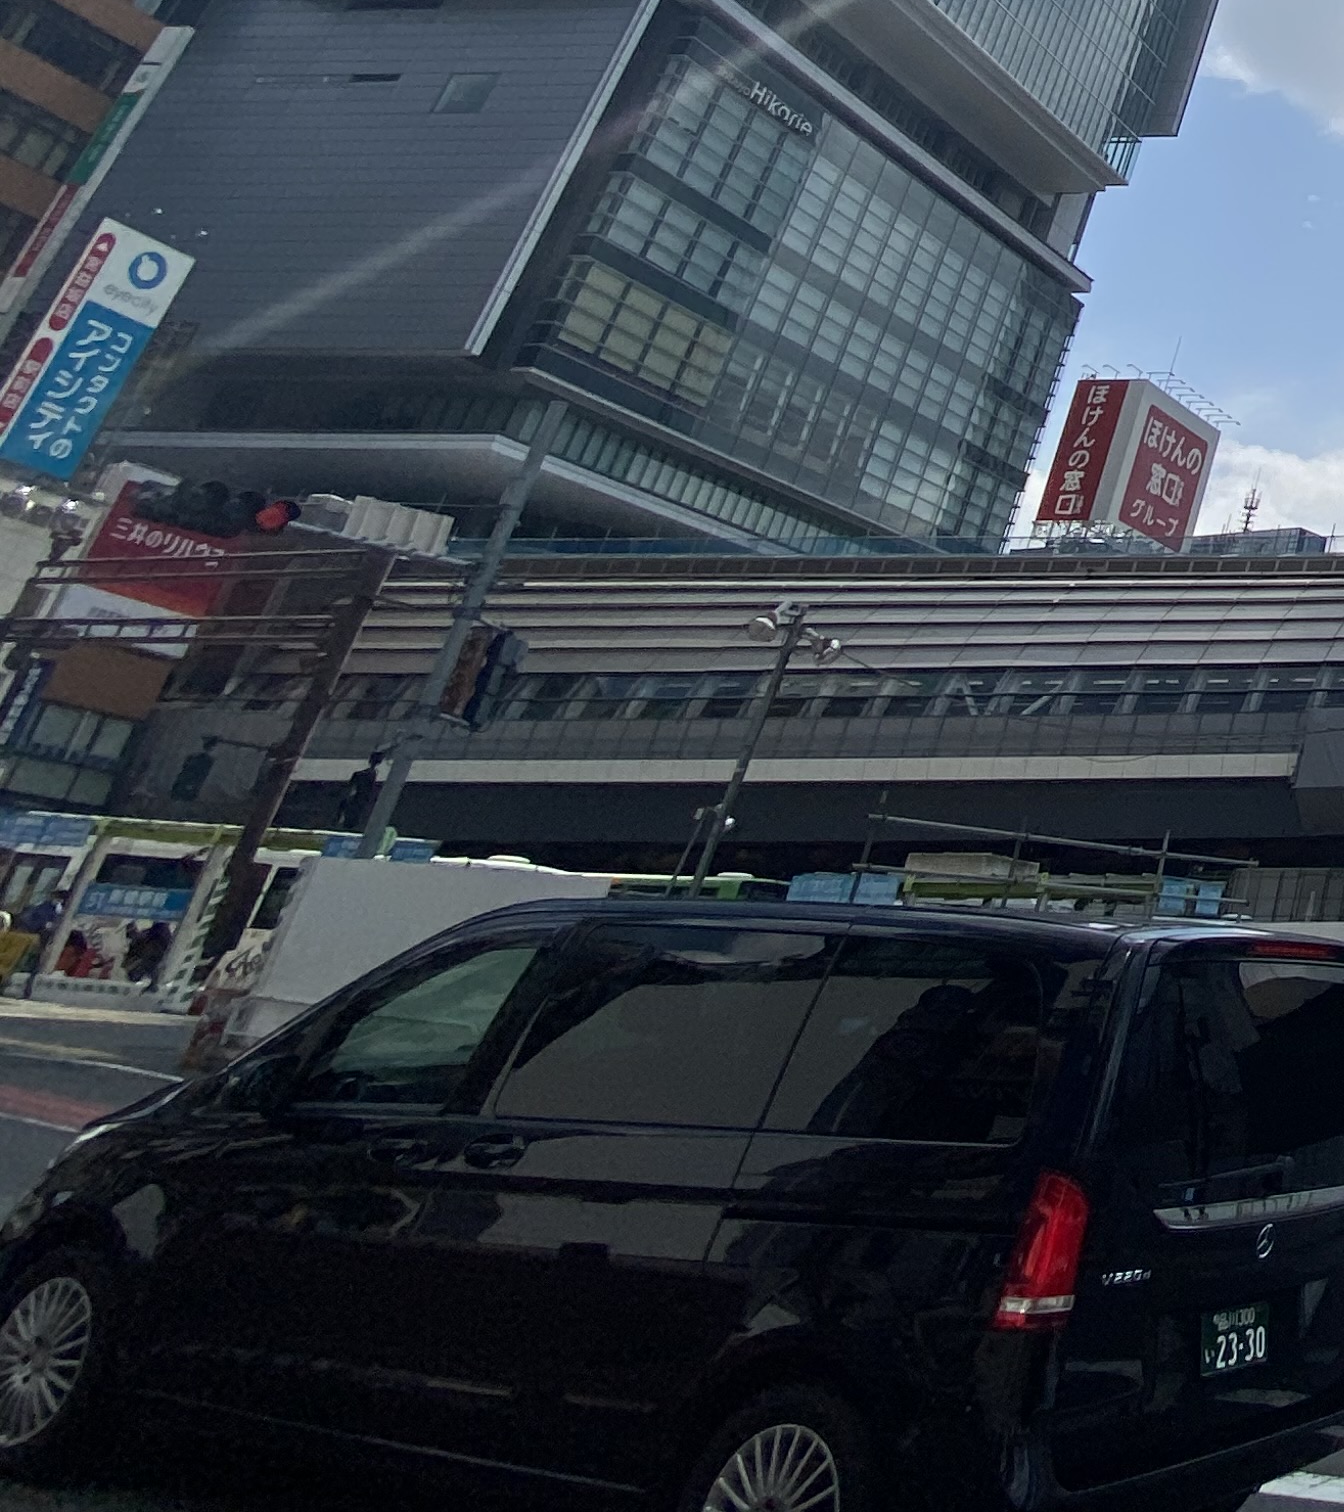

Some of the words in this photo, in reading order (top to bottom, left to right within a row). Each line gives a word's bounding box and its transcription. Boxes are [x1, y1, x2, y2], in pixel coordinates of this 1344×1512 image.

[749, 81, 813, 136] Hikarie
[28, 319, 113, 450] アイシティ
[50, 331, 133, 459] コンタクトの
[1054, 384, 1109, 516] ほけんの窓口
[1143, 416, 1202, 475] ほけんの
[1145, 463, 1185, 506] 窓口
[1129, 498, 1179, 538] グループ
